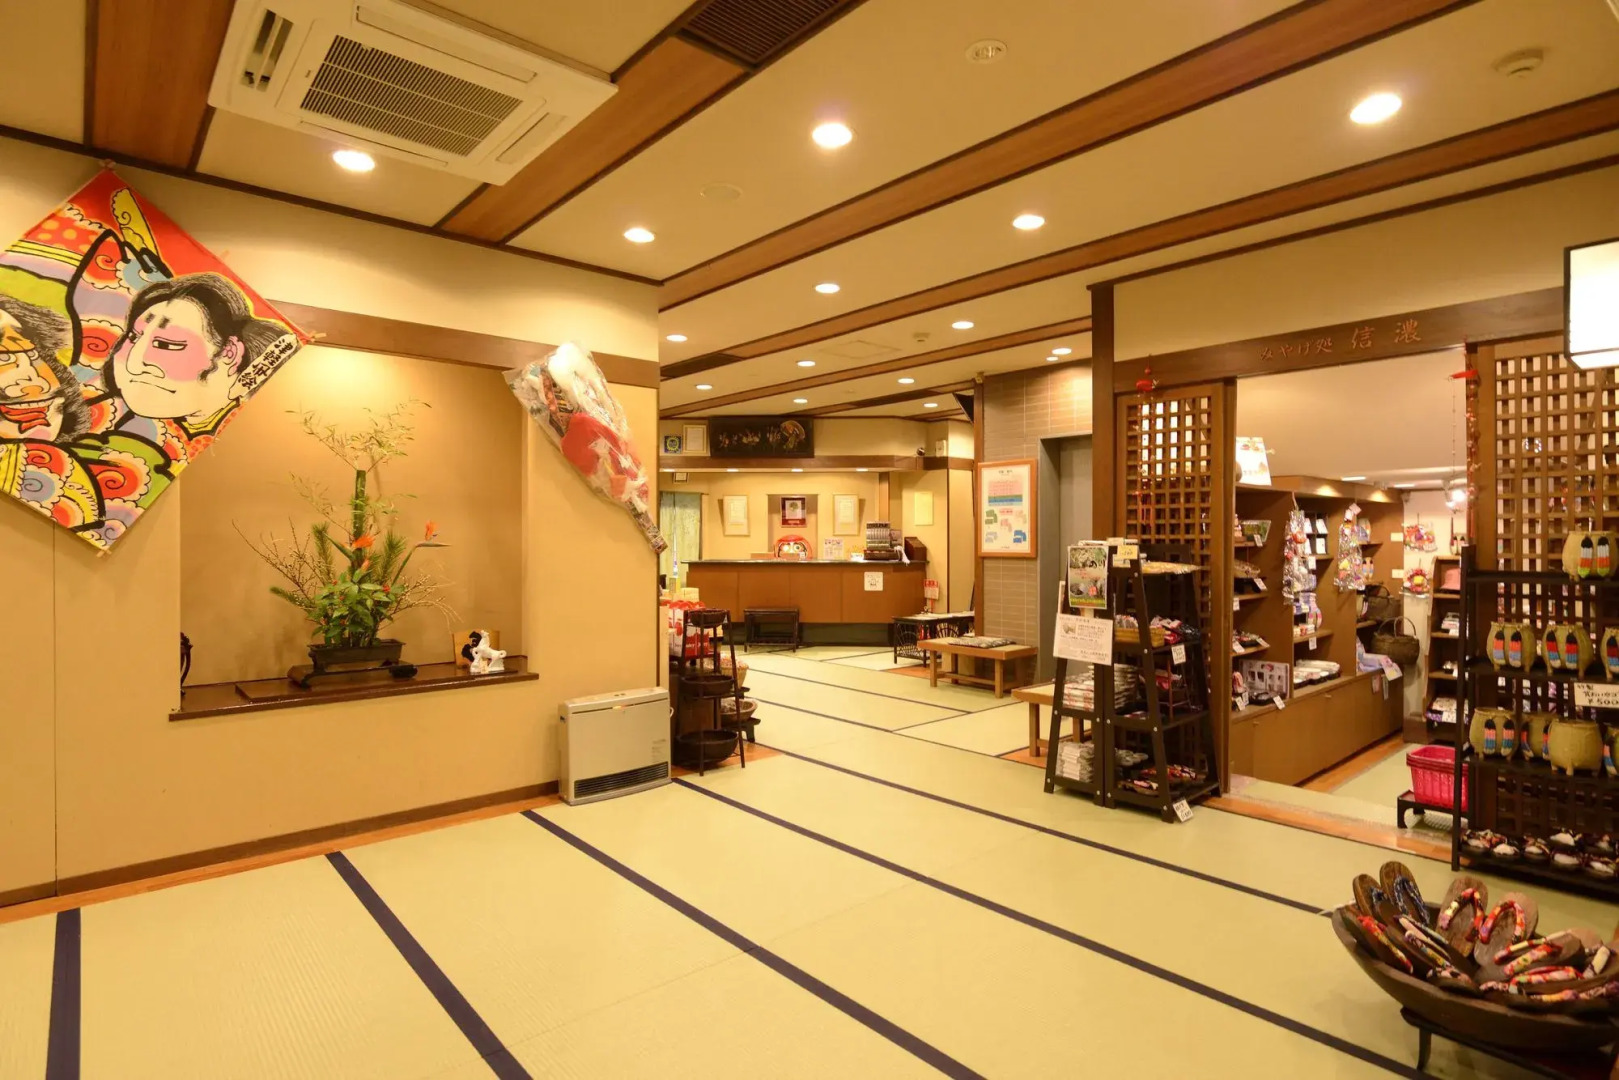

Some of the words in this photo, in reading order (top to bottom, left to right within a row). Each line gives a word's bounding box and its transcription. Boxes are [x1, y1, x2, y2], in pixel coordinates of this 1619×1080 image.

[1261, 337, 1332, 361] みやげ処
[1351, 319, 1422, 349] 信濃
